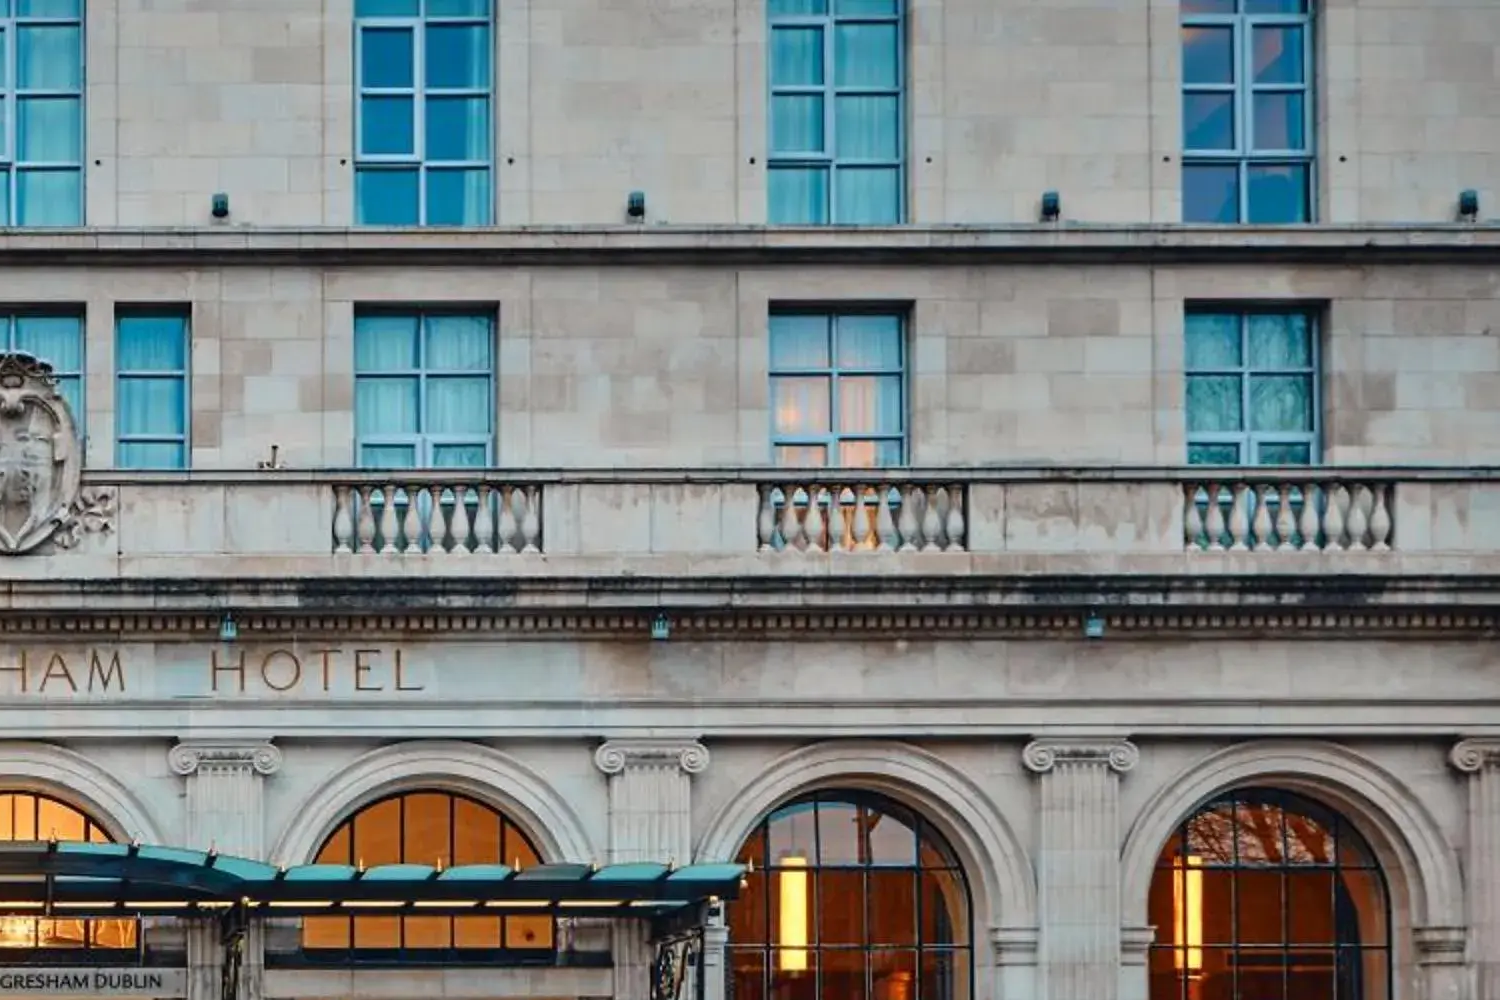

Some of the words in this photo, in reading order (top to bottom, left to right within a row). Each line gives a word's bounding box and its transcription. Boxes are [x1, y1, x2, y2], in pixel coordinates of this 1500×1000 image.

[211, 649, 424, 692] HOTEL
[0, 974, 89, 989] GRESHAM
[94, 973, 163, 989] DUBLIN
